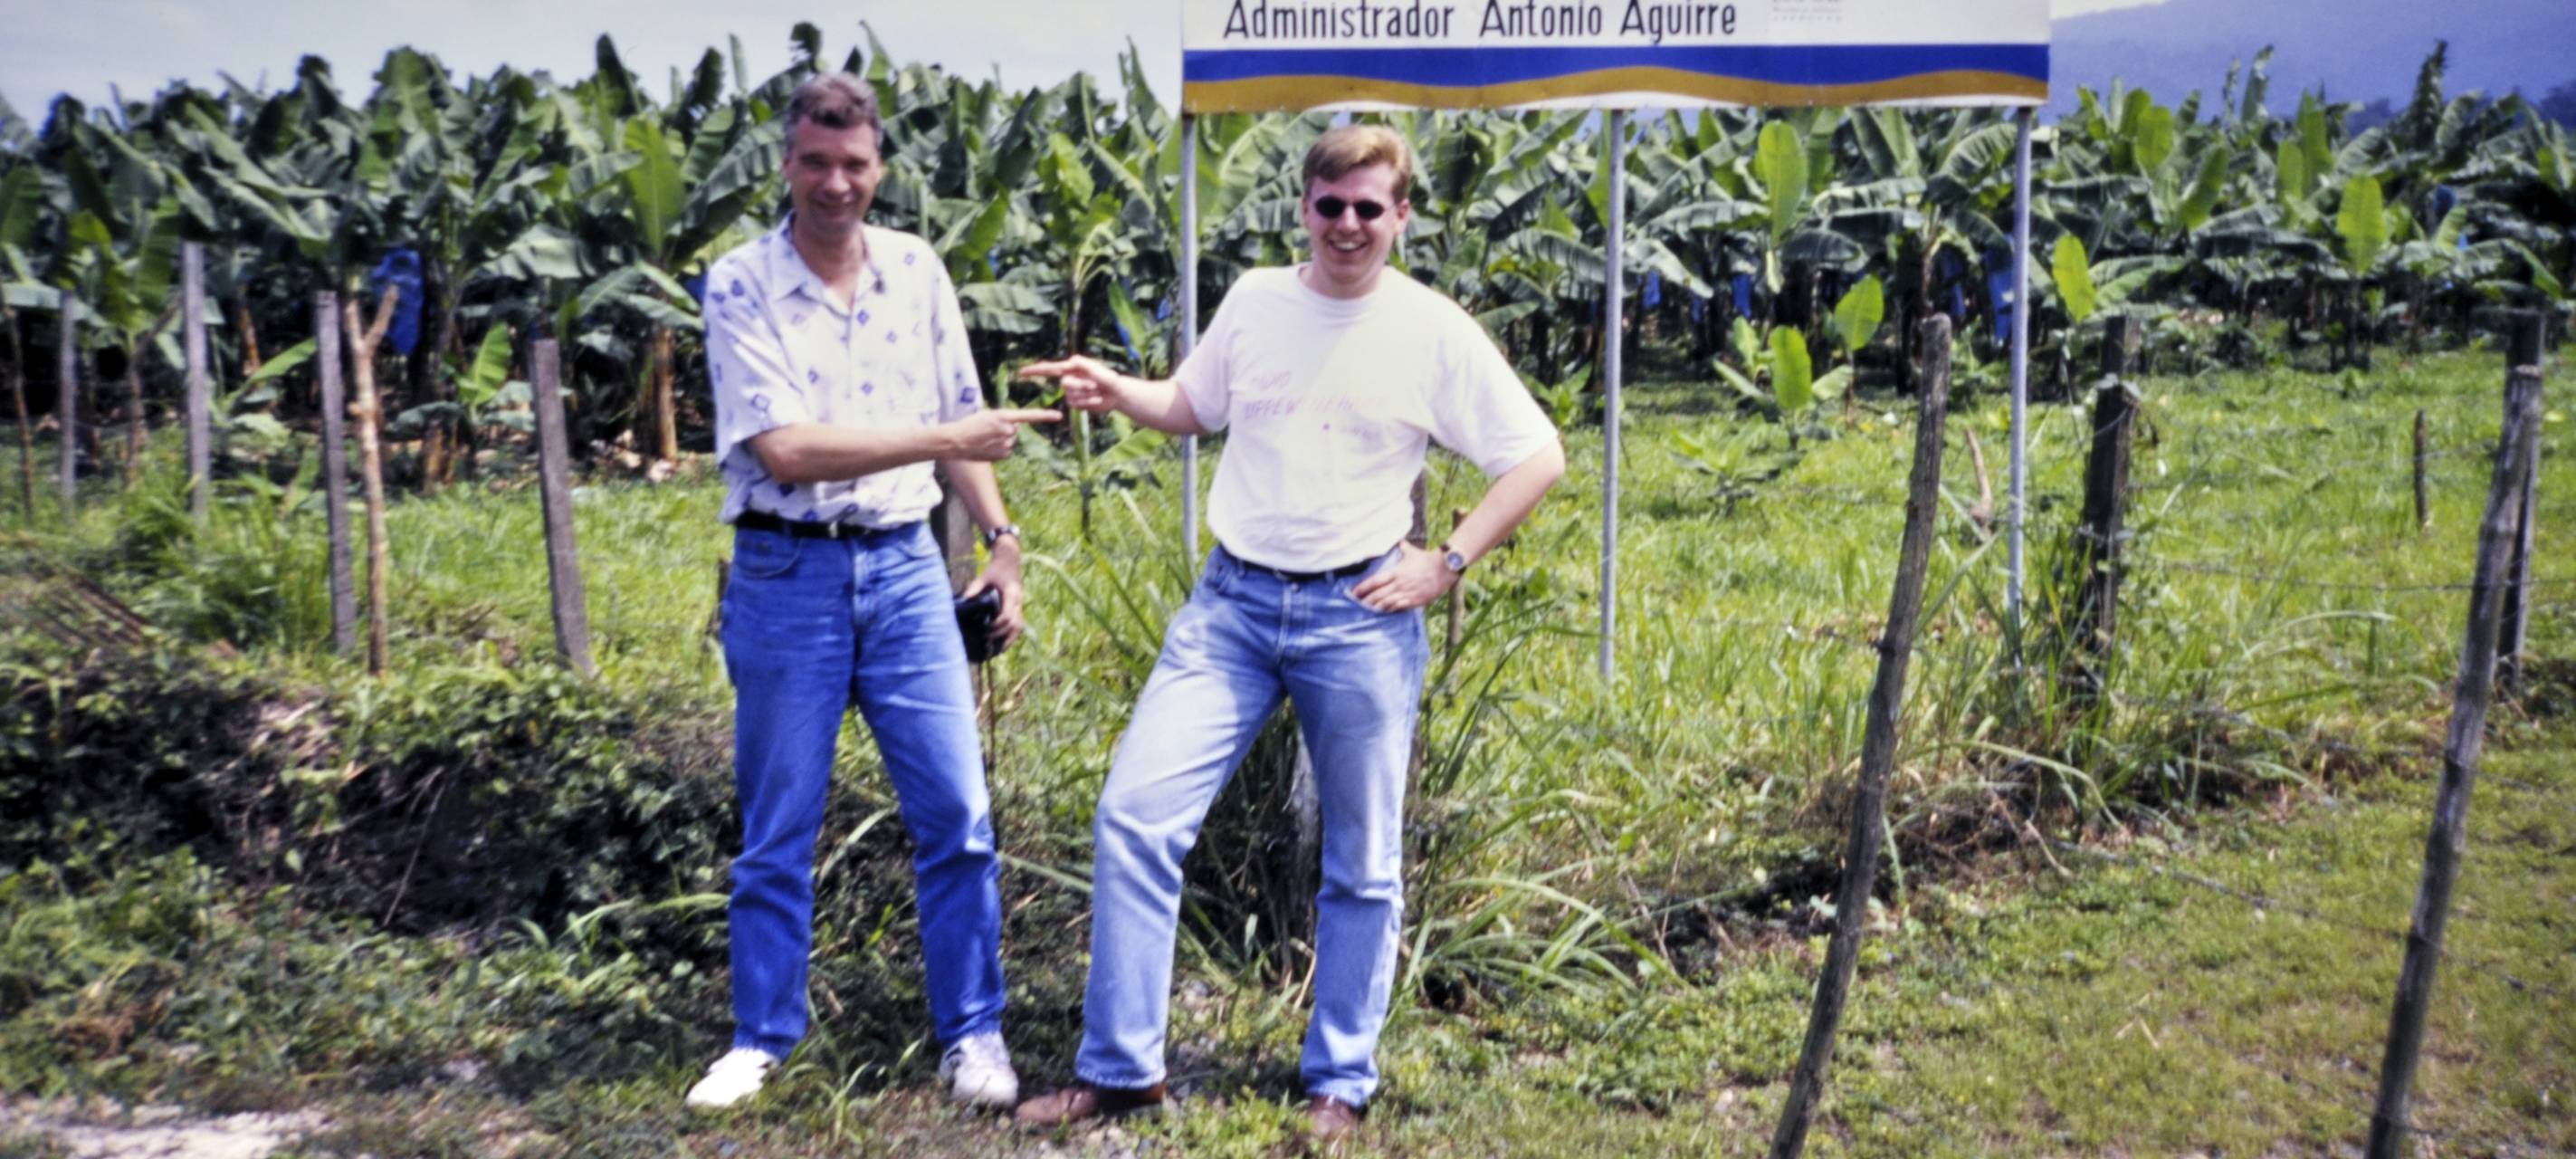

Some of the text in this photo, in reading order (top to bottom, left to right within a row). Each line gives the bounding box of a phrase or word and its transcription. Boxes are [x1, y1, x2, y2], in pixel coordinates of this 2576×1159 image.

[1223, 0, 1736, 44] Administrador Antonio Aguirre
